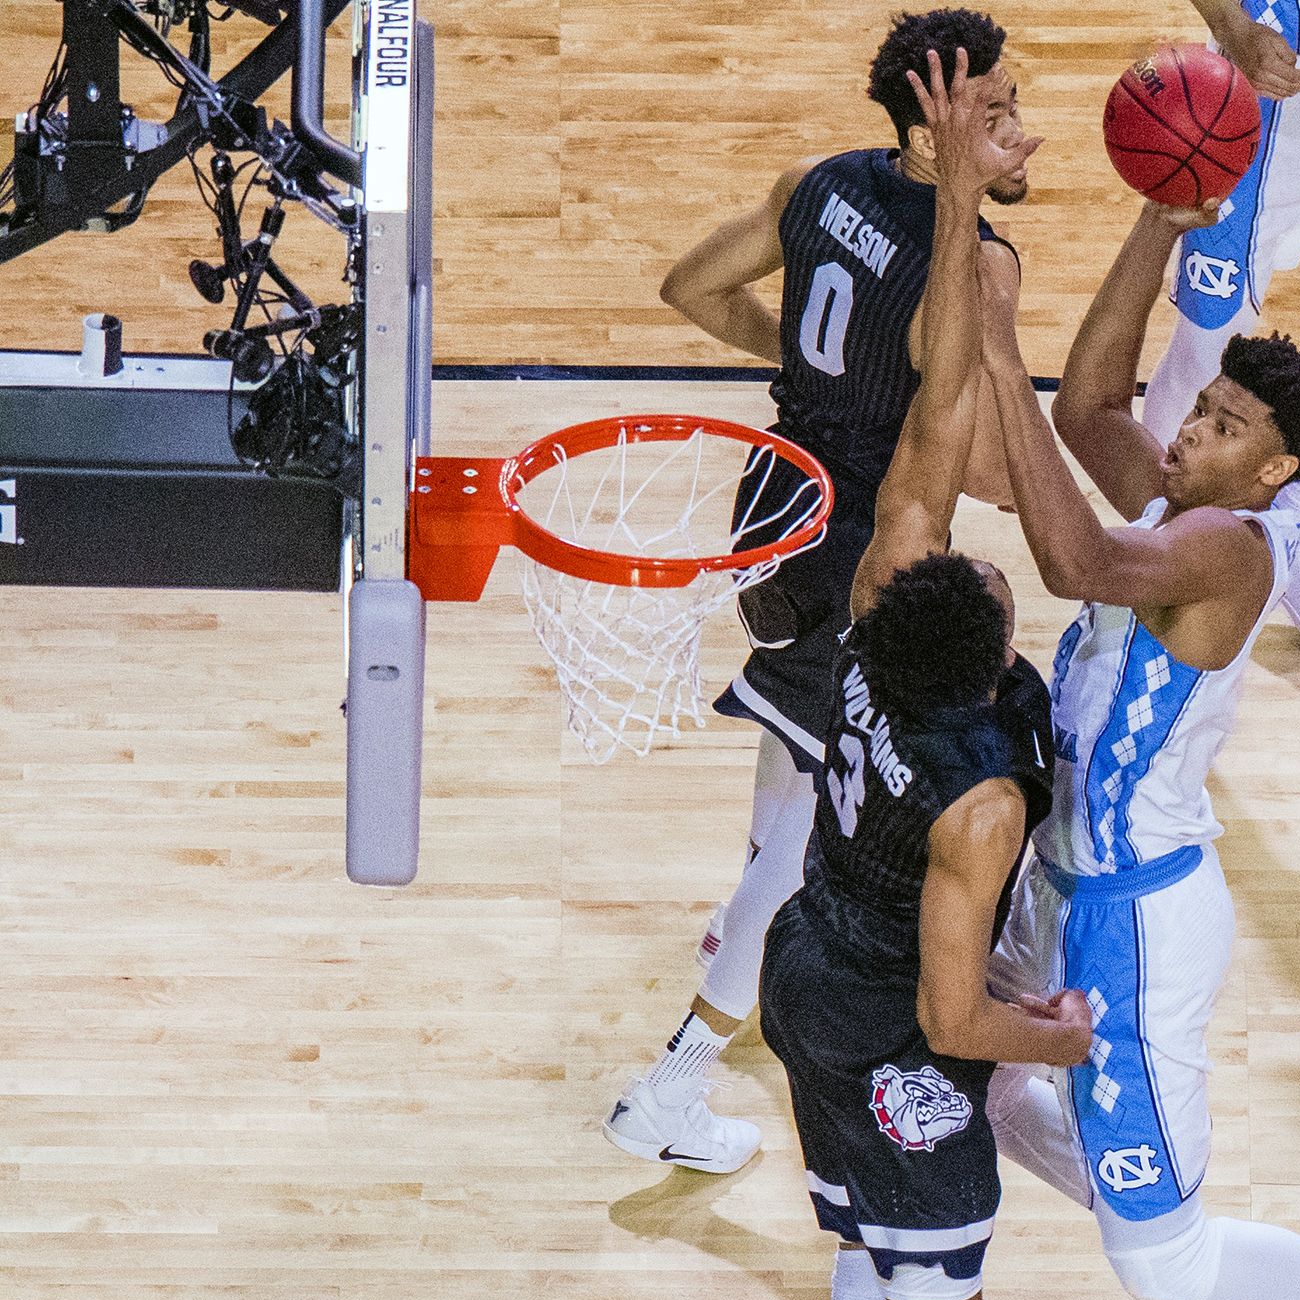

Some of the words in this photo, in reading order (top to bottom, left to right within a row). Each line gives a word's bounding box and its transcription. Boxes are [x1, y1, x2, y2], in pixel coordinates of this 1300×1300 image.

[818, 192, 898, 279] MELSON
[799, 261, 854, 377] 0
[842, 661, 913, 798] WILLIAMS
[826, 732, 866, 839] 3
